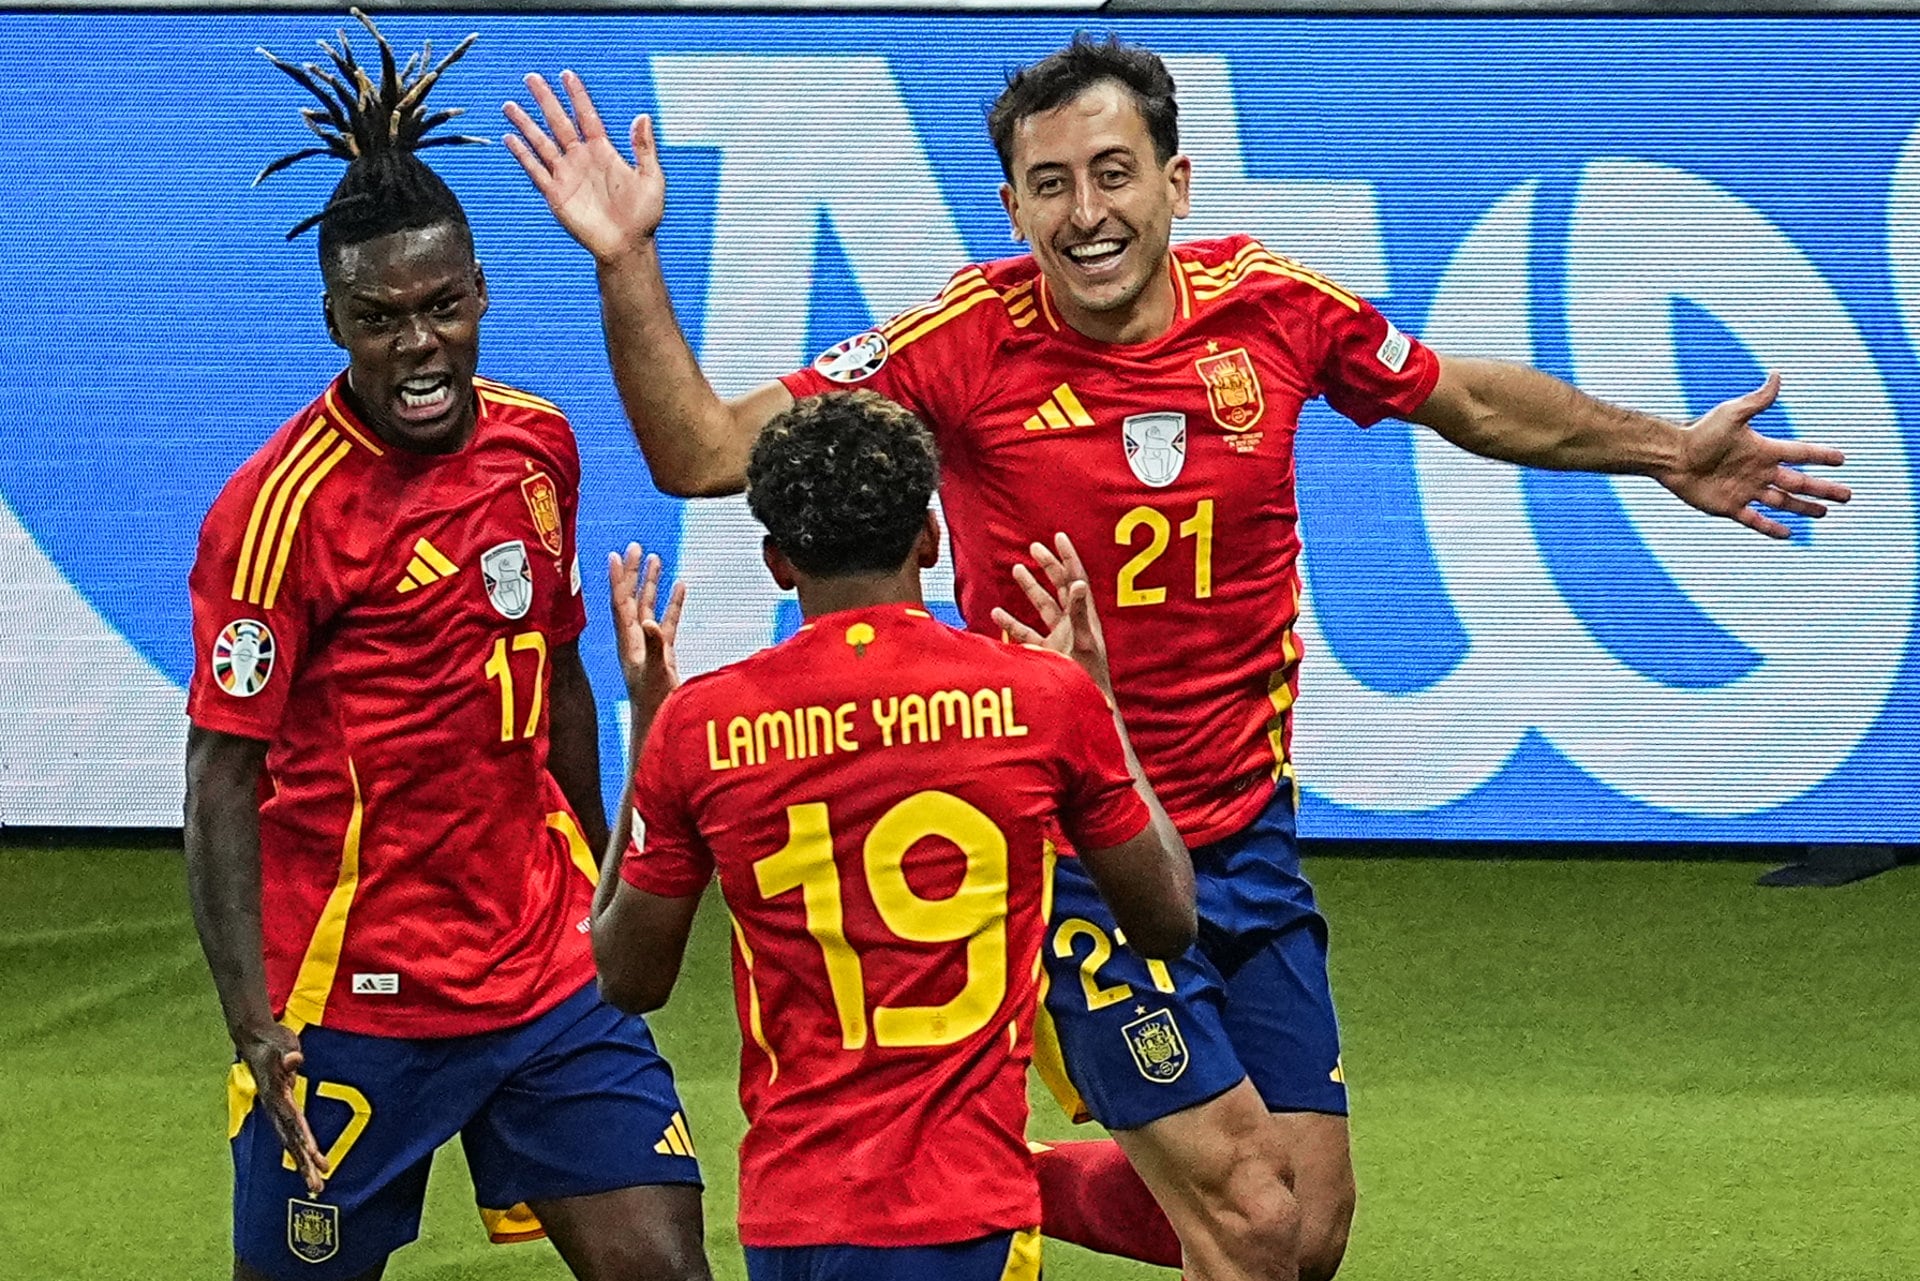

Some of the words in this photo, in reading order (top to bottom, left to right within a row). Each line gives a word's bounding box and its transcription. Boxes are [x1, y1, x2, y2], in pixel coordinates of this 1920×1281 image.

[1114, 499, 1213, 608] 21
[484, 631, 547, 742] 17
[707, 702, 859, 770] LAMINE
[872, 687, 1028, 746] YAMAL
[753, 790, 1008, 1050] 19
